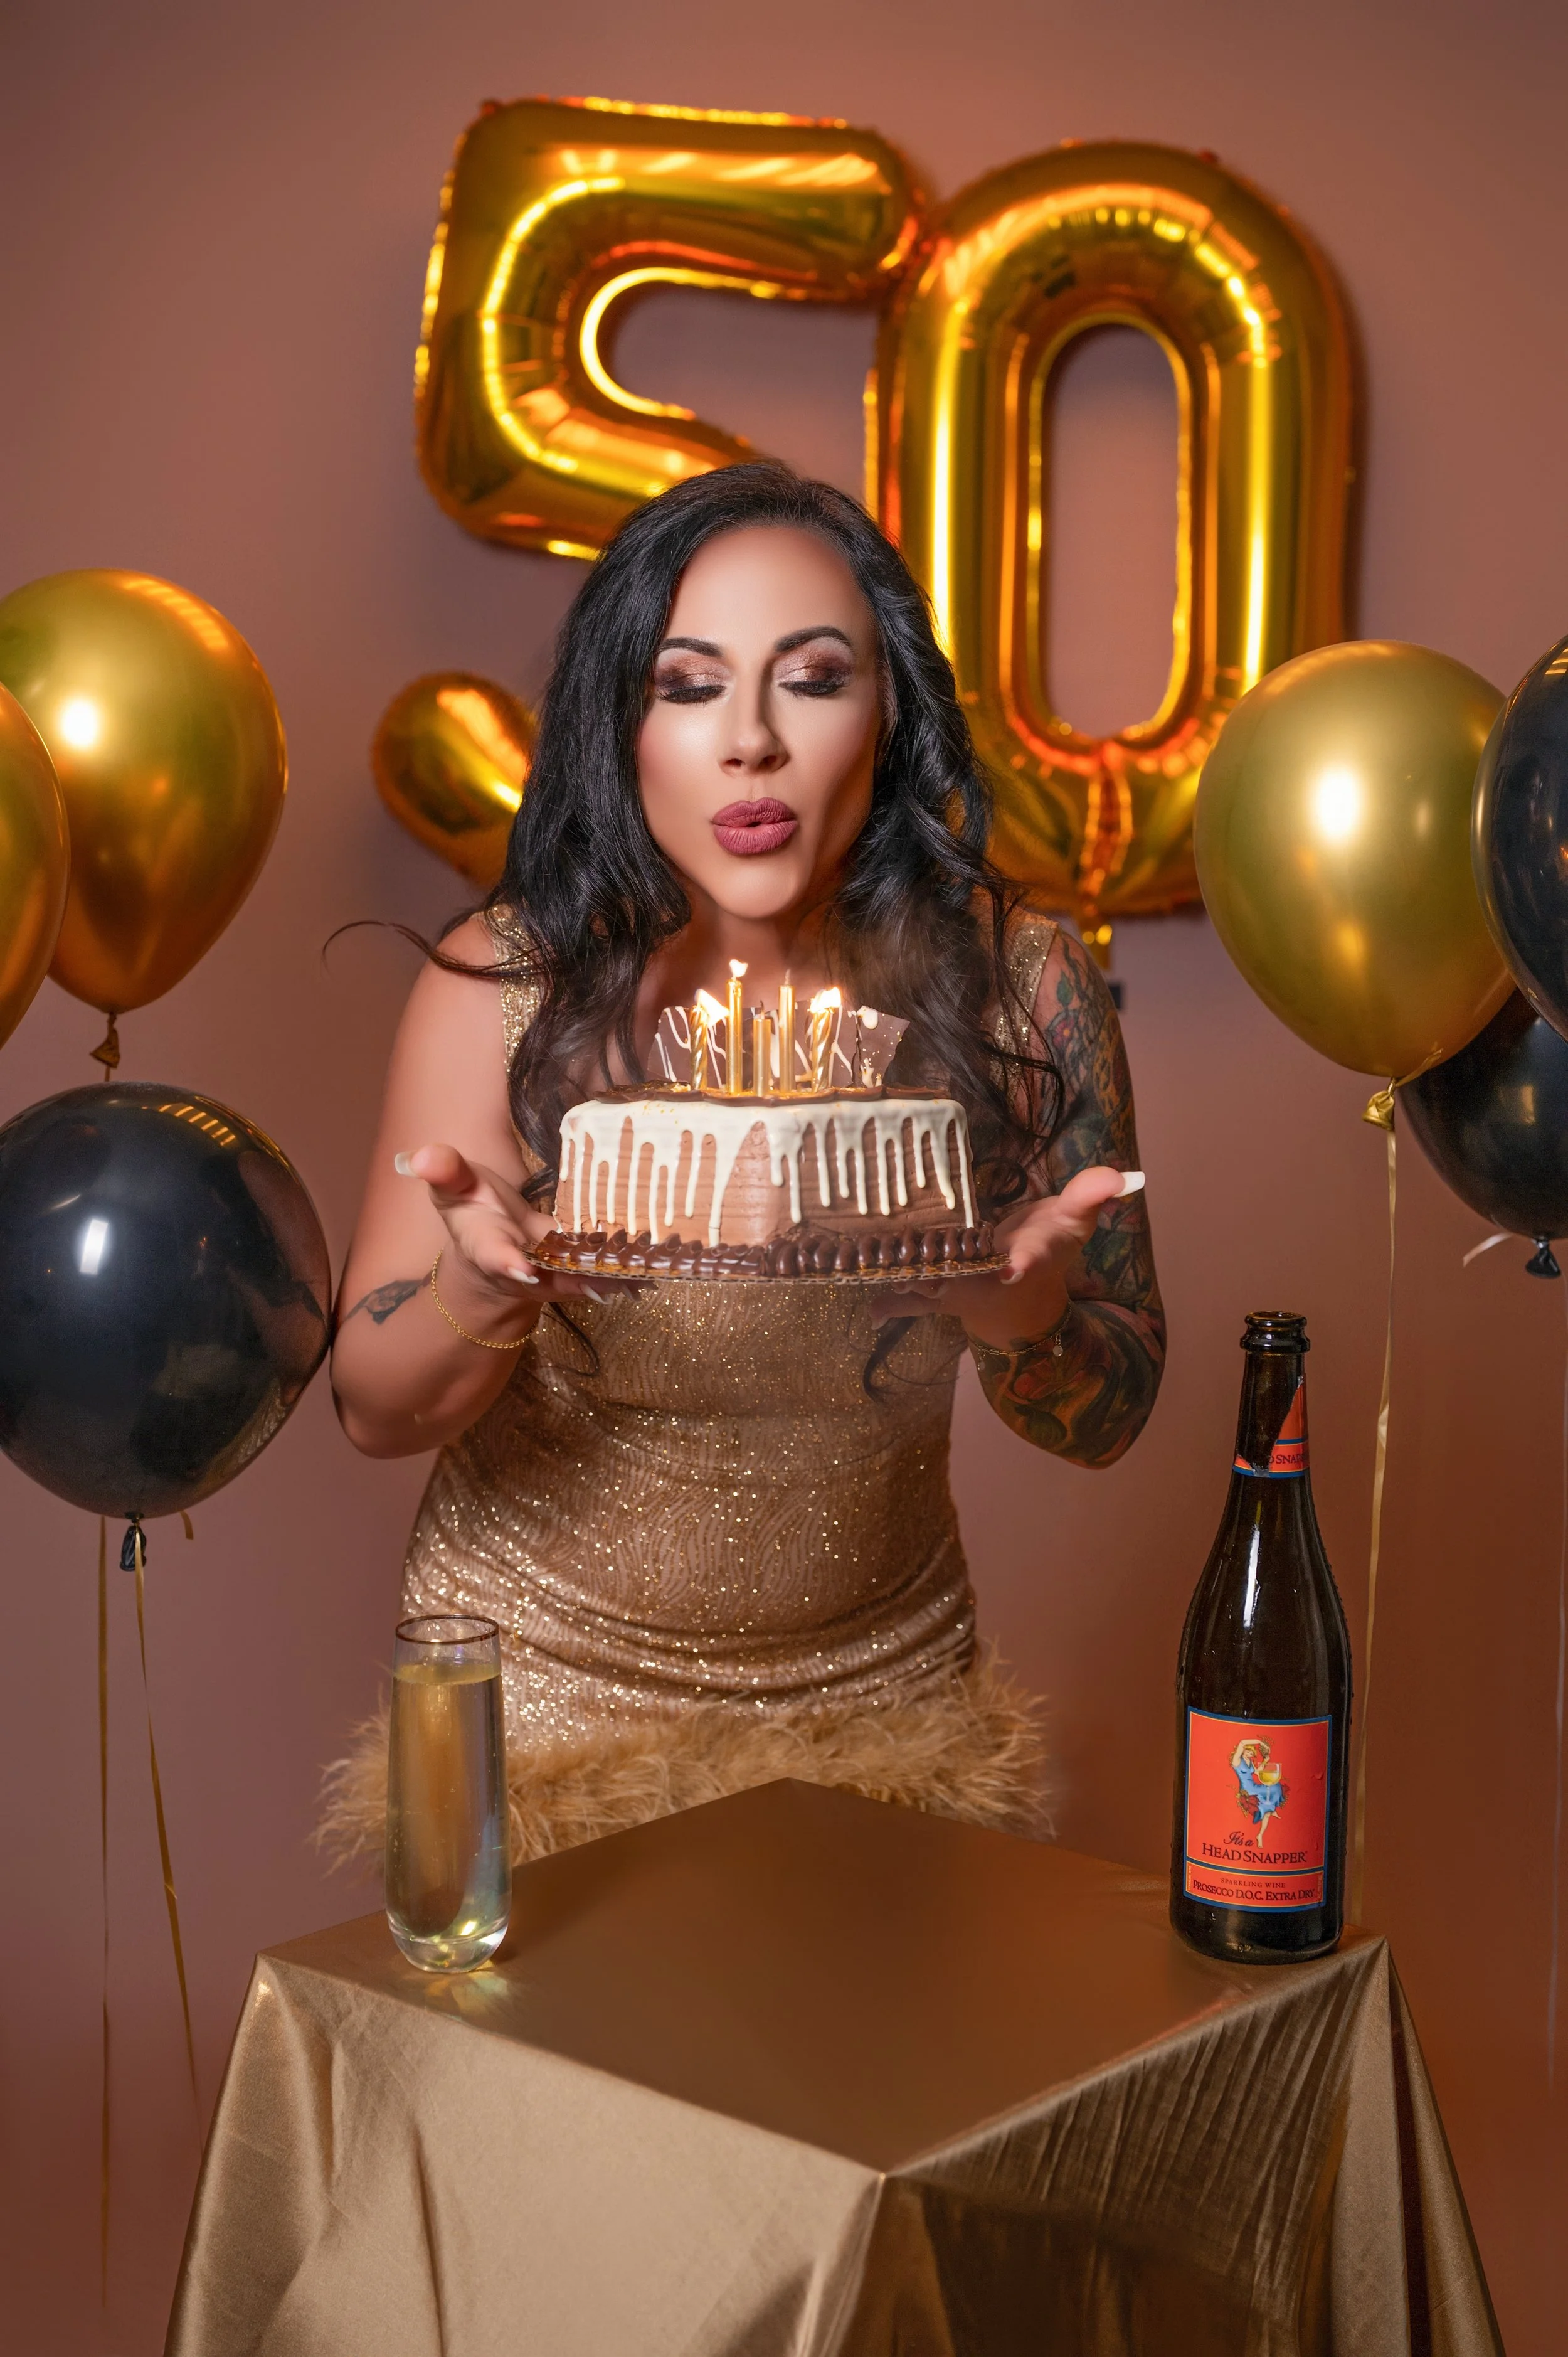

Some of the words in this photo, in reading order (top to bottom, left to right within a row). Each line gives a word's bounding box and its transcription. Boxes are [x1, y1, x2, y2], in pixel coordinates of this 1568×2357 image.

[371, 94, 1358, 917] 50
[1223, 1831, 1244, 1846] It's
[1245, 1839, 1254, 1848] a
[1202, 1842, 1241, 1861] HEAD
[1243, 1850, 1308, 1864] SNAPPER
[1193, 1879, 1234, 1897] PROSECCO
[1236, 1889, 1264, 1901] D.O.C.
[1266, 1891, 1297, 1901] EXTRA
[1298, 1888, 1315, 1900] DRY
[1221, 1878, 1262, 1888] SPARKLING
